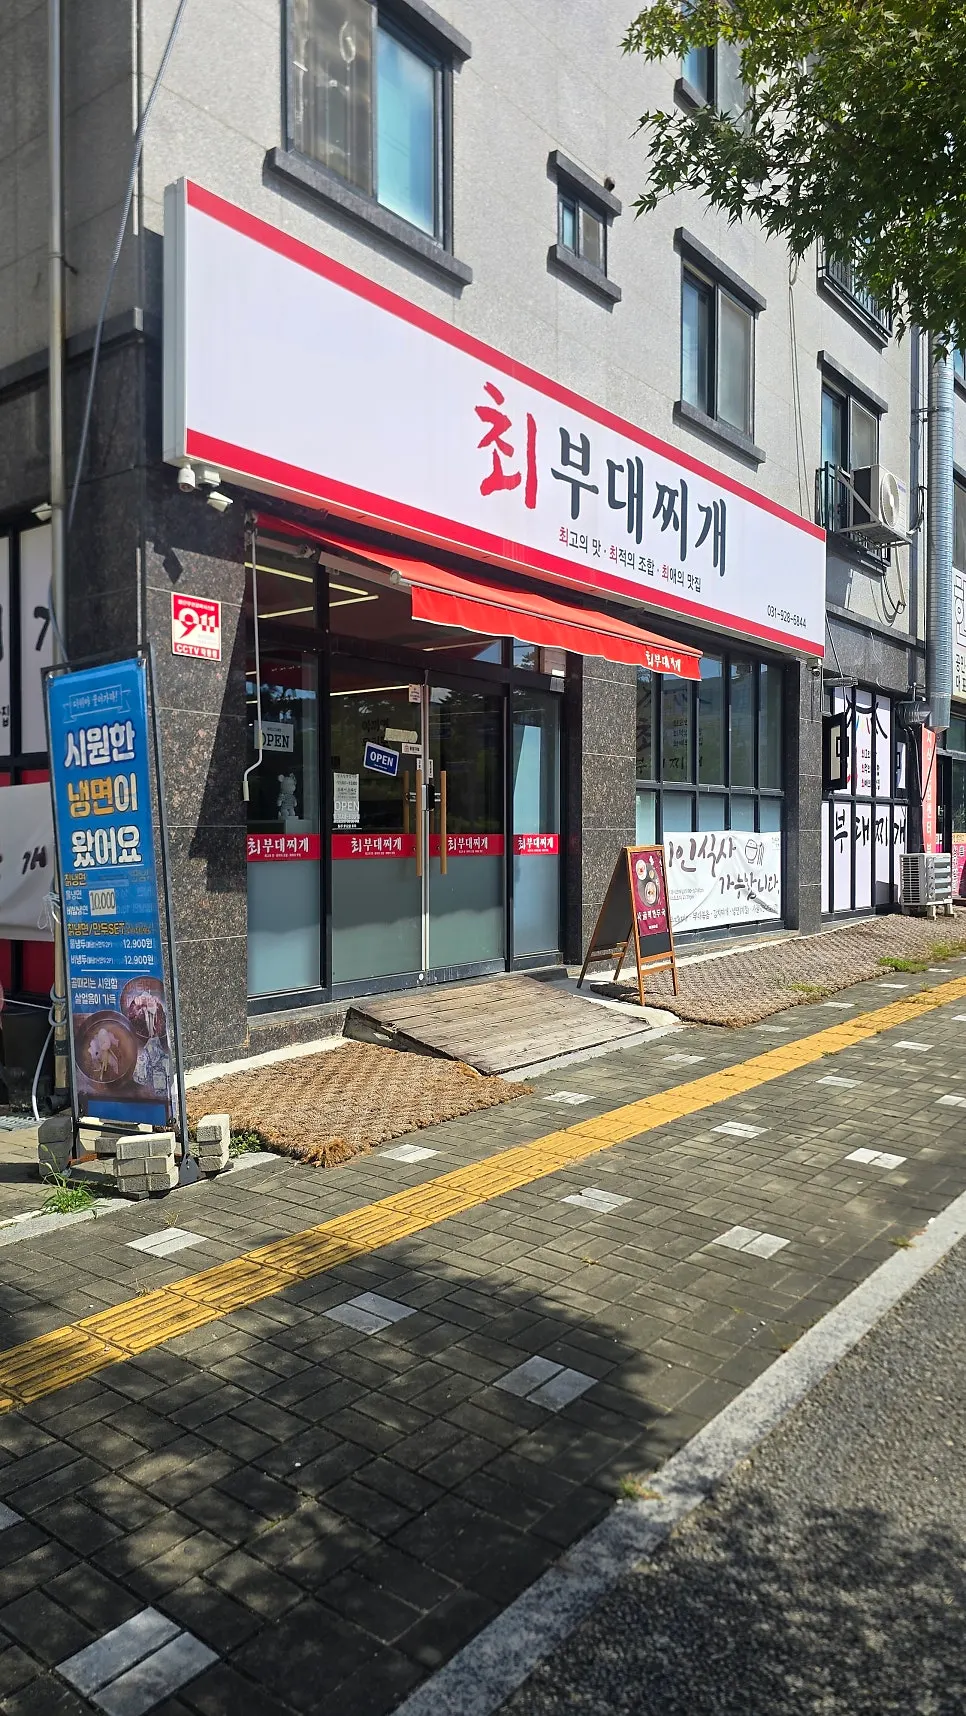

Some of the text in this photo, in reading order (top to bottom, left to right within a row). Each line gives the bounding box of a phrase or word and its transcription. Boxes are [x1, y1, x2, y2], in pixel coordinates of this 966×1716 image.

[559, 526, 702, 593] 최고의 맛 최적의 조합 최애의 맛집
[178, 607, 216, 639] 911
[176, 644, 200, 656] CCTV
[65, 720, 136, 769] 시원한
[369, 751, 394, 767] OPEN
[67, 771, 139, 819] 냉면이
[334, 801, 360, 811] OPEN
[71, 825, 142, 868] 왔어요
[247, 837, 309, 855] 최부대찌개
[351, 837, 402, 853] 최부대찌개
[447, 837, 488, 851] 최부대찌개
[518, 837, 554, 850] 최부대찌개
[64, 872, 87, 887] 칡냉면
[66, 904, 88, 916] 비빔냉면
[71, 977, 118, 990] 골때리는 시원함
[74, 992, 117, 1005] 살얼음이 가득
